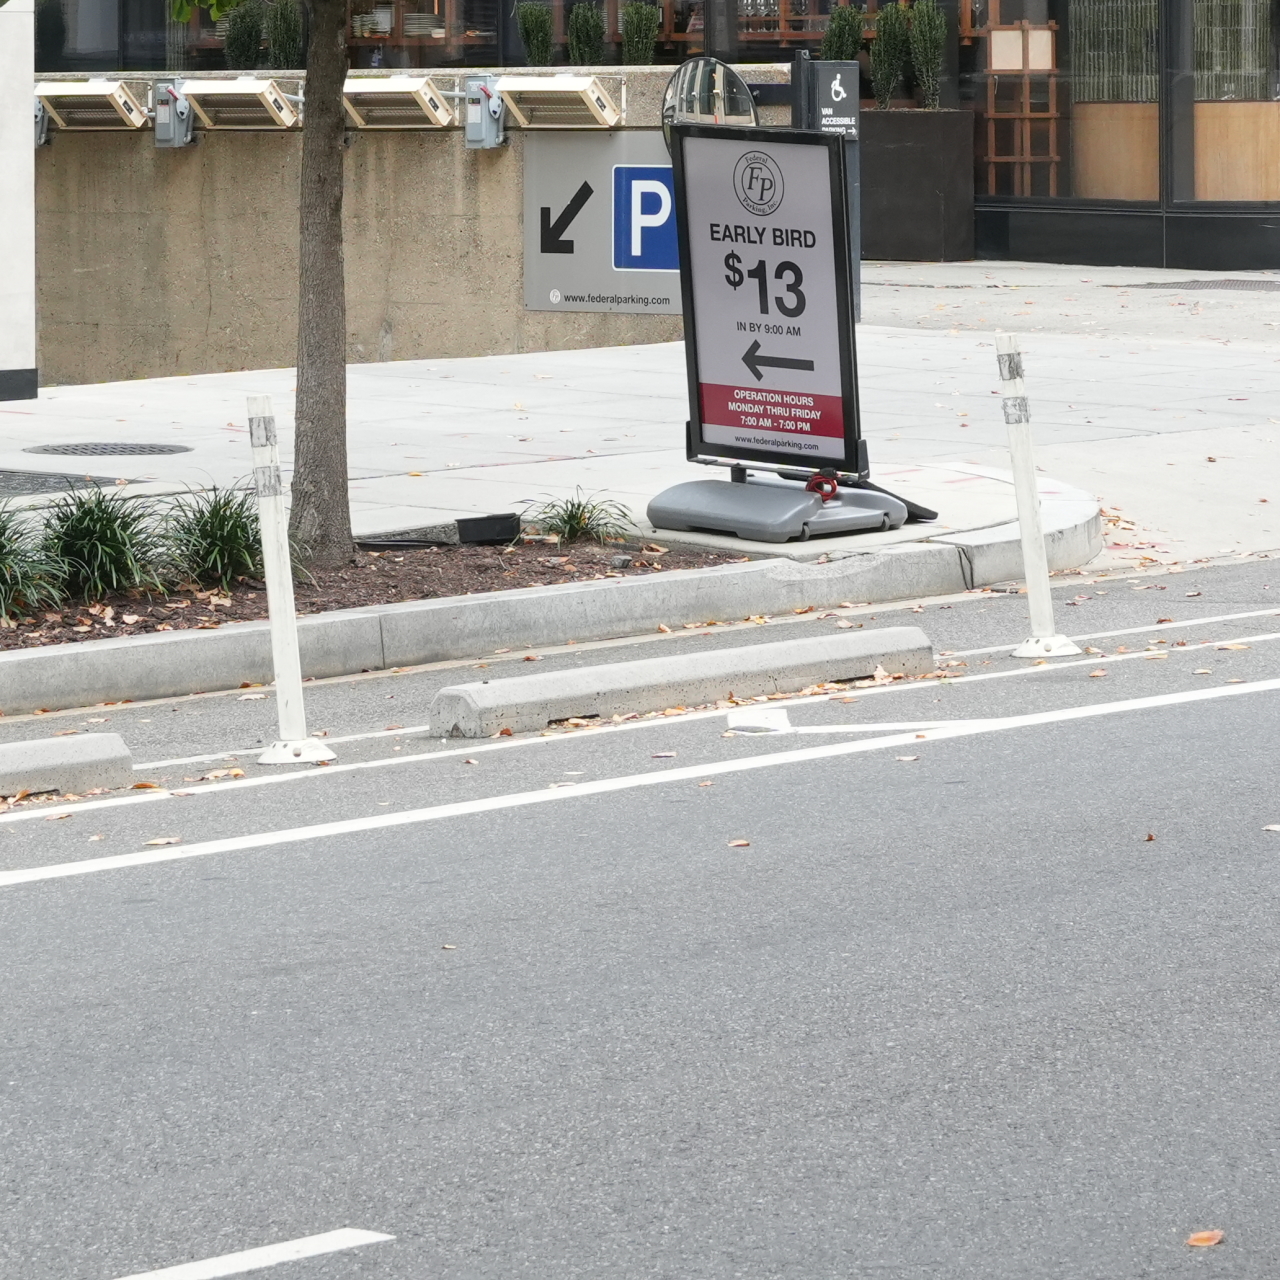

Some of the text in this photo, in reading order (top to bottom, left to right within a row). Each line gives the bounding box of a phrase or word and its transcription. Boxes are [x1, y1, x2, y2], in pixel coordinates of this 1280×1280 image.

[821, 117, 855, 125] ACCESSIBLE
[745, 154, 768, 164] Federal
[747, 166, 774, 201] FP
[631, 180, 672, 256] P
[710, 223, 816, 248] EARLY BIRD
[724, 249, 806, 318] $13
[564, 293, 670, 307] www.federalparking.com
[736, 321, 801, 336] IN BY 9:00 AM
[734, 389, 814, 406] OPERATION HOURS
[728, 402, 821, 420] MONDAY THRU FRIDAY
[740, 416, 757, 425] 7:00
[759, 417, 772, 427] AM
[779, 420, 795, 430] 7:00
[797, 422, 810, 431] PM
[735, 433, 819, 451] www.federalparking.com
